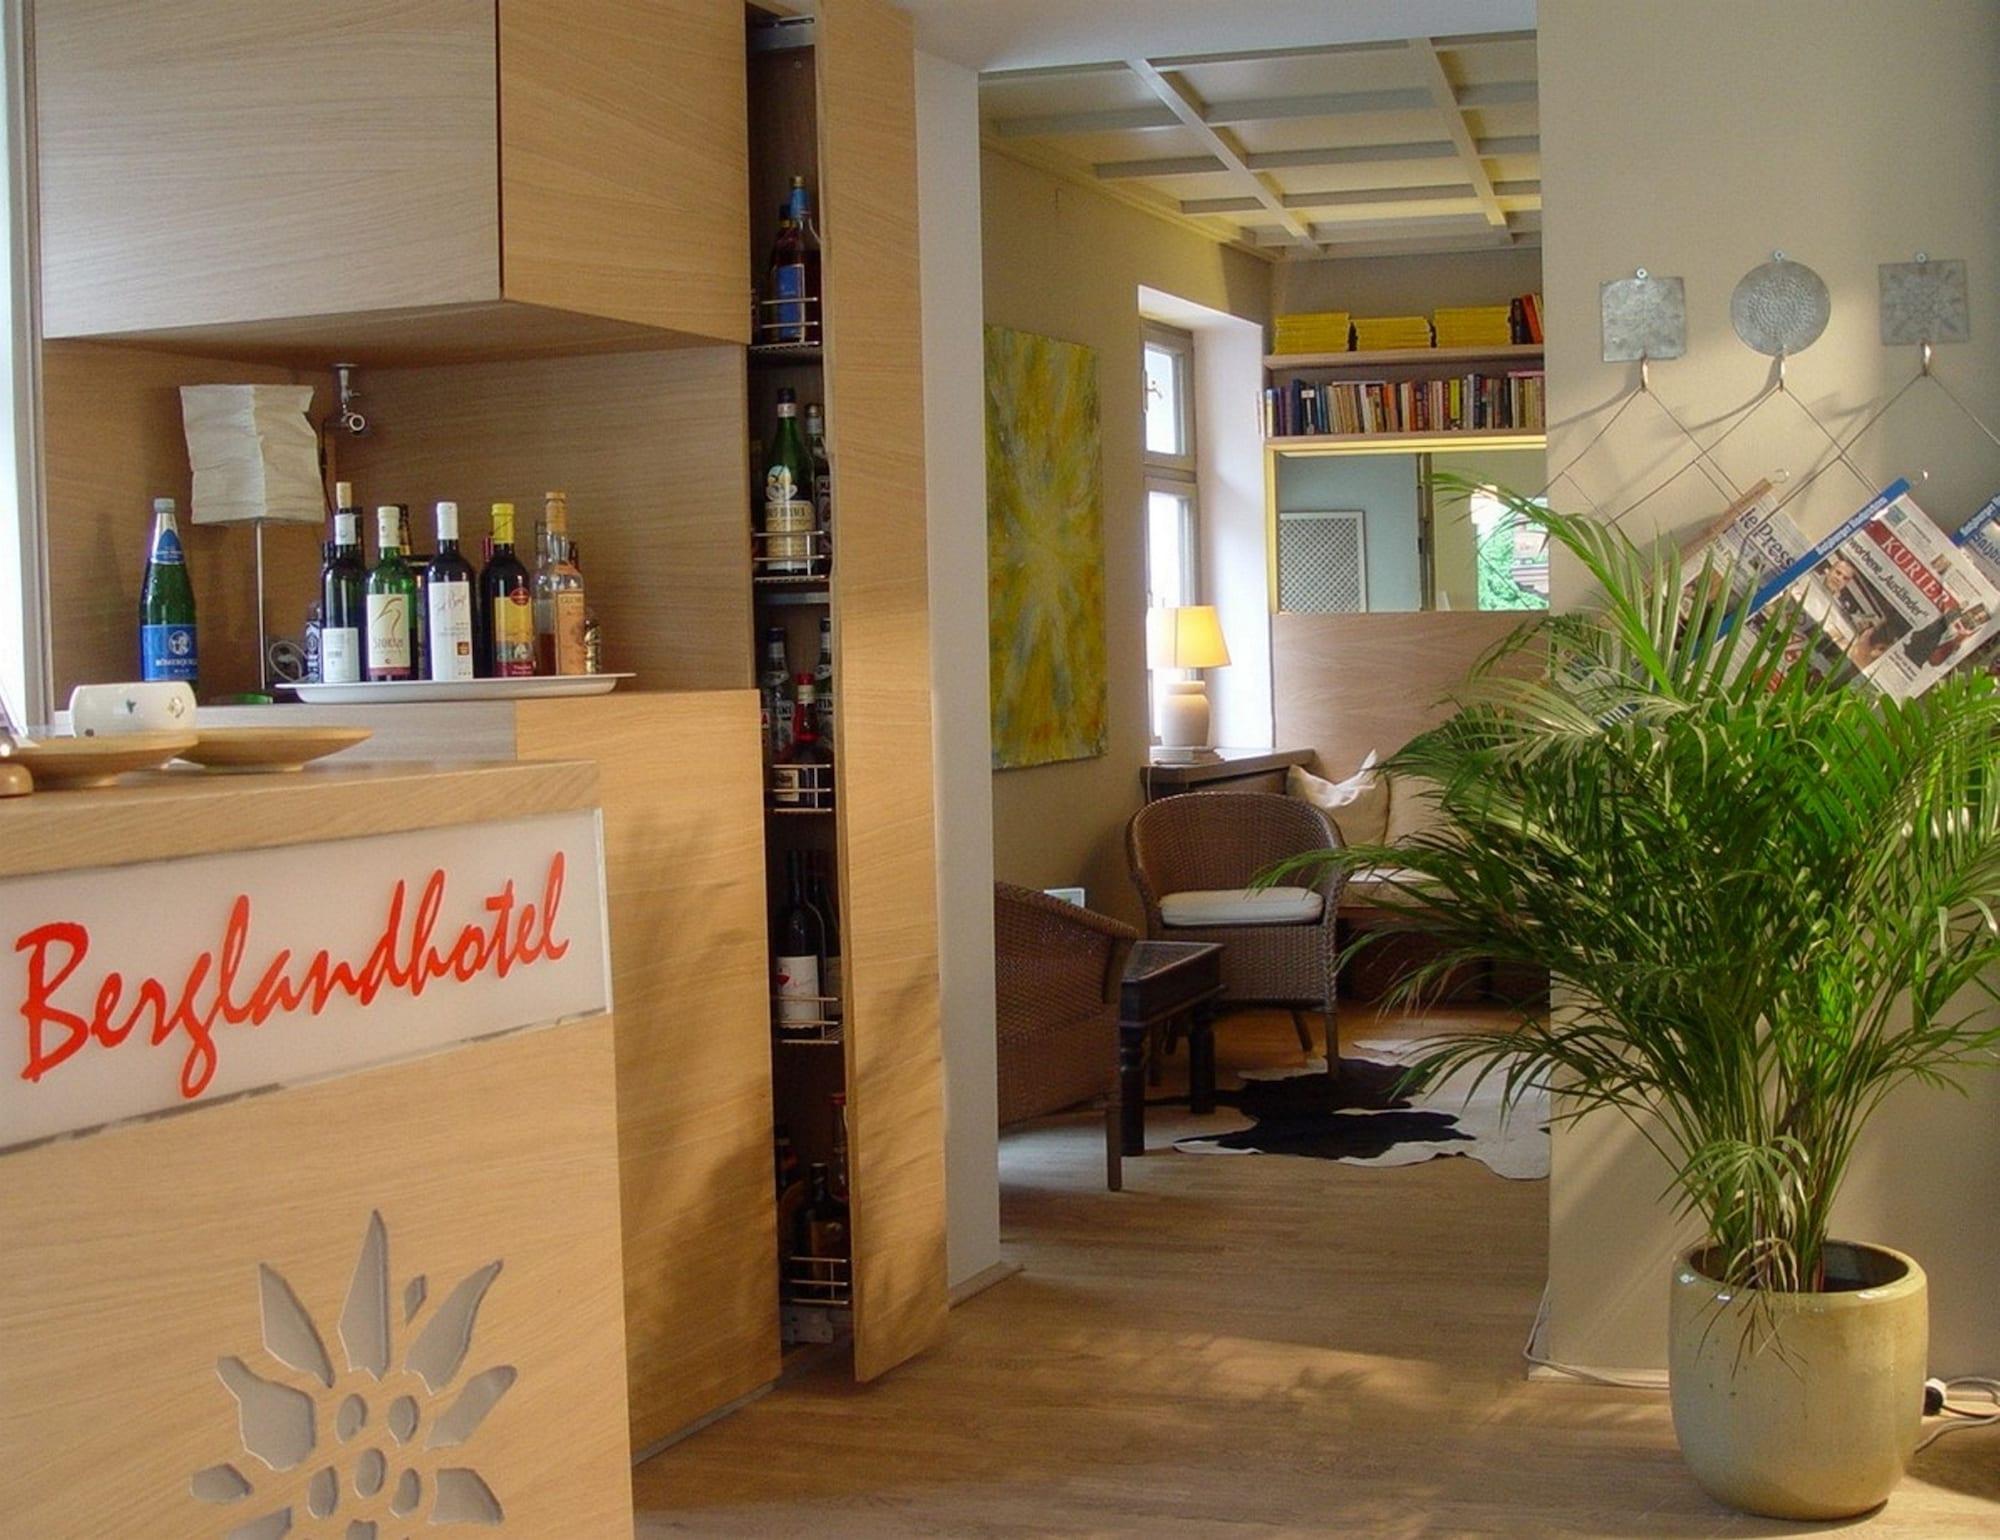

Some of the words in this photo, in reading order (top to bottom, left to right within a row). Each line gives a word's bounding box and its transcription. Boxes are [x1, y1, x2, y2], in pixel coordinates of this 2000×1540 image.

[1739, 507, 1758, 530] ie
[1752, 522, 1795, 570] Press
[1881, 536, 1951, 614] KURIER
[15, 851, 571, 1099] Berglandhotel
